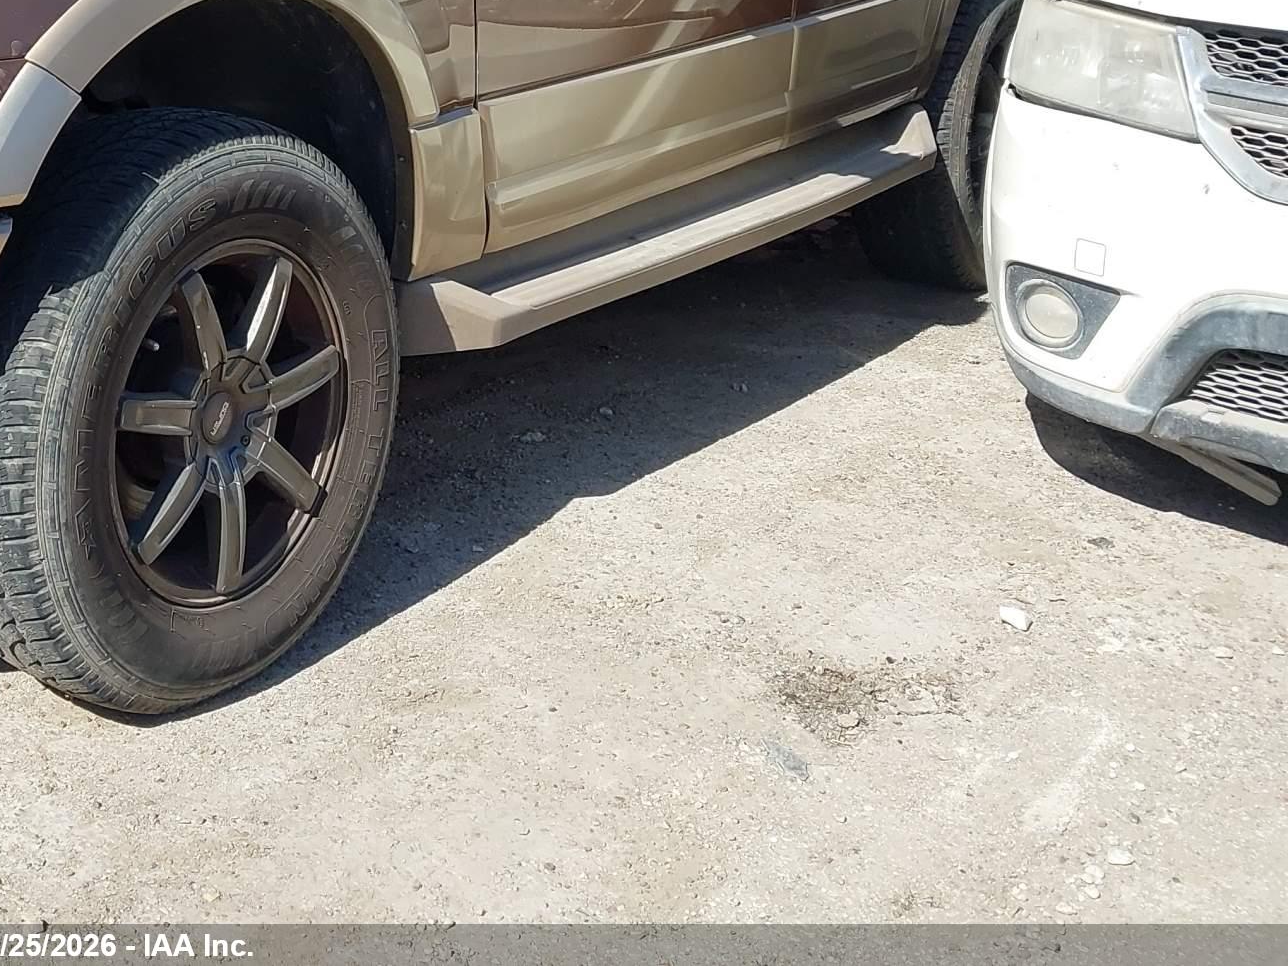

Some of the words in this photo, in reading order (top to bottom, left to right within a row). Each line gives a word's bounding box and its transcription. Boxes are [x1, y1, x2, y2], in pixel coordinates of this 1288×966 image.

[73, 197, 218, 556] AMERICUS
[369, 329, 389, 412] ALL
[284, 426, 384, 628] TERRAIN
